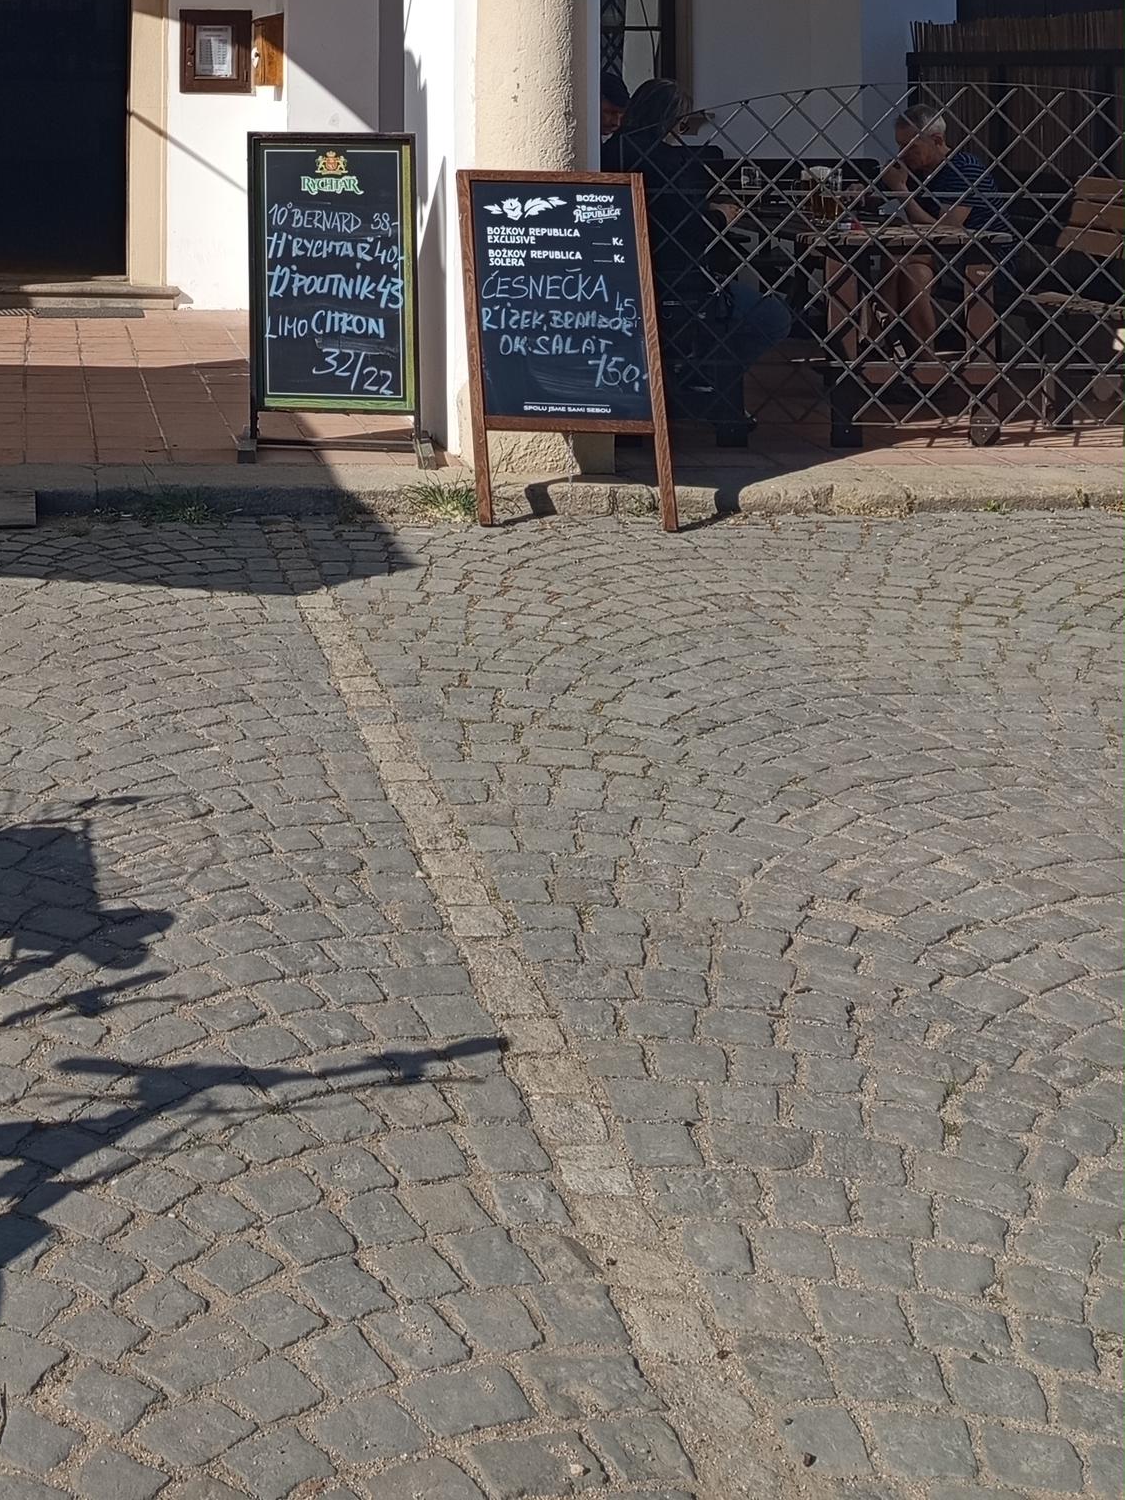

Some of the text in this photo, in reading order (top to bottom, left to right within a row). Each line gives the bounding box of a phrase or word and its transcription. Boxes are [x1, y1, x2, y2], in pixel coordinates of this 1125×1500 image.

[576, 193, 615, 203] BOŽKOV
[573, 205, 623, 224] REPUBLICA
[291, 208, 362, 234] BERNARD
[486, 225, 581, 238] BOŽKOV REPUBLICA
[487, 235, 536, 245] EXCLUSIVE
[488, 248, 582, 260] BOŽKOV REPUBLICA
[488, 257, 526, 267] SOLERA
[264, 309, 386, 339] LIMO CITRON
[523, 404, 547, 412] SPOLU
